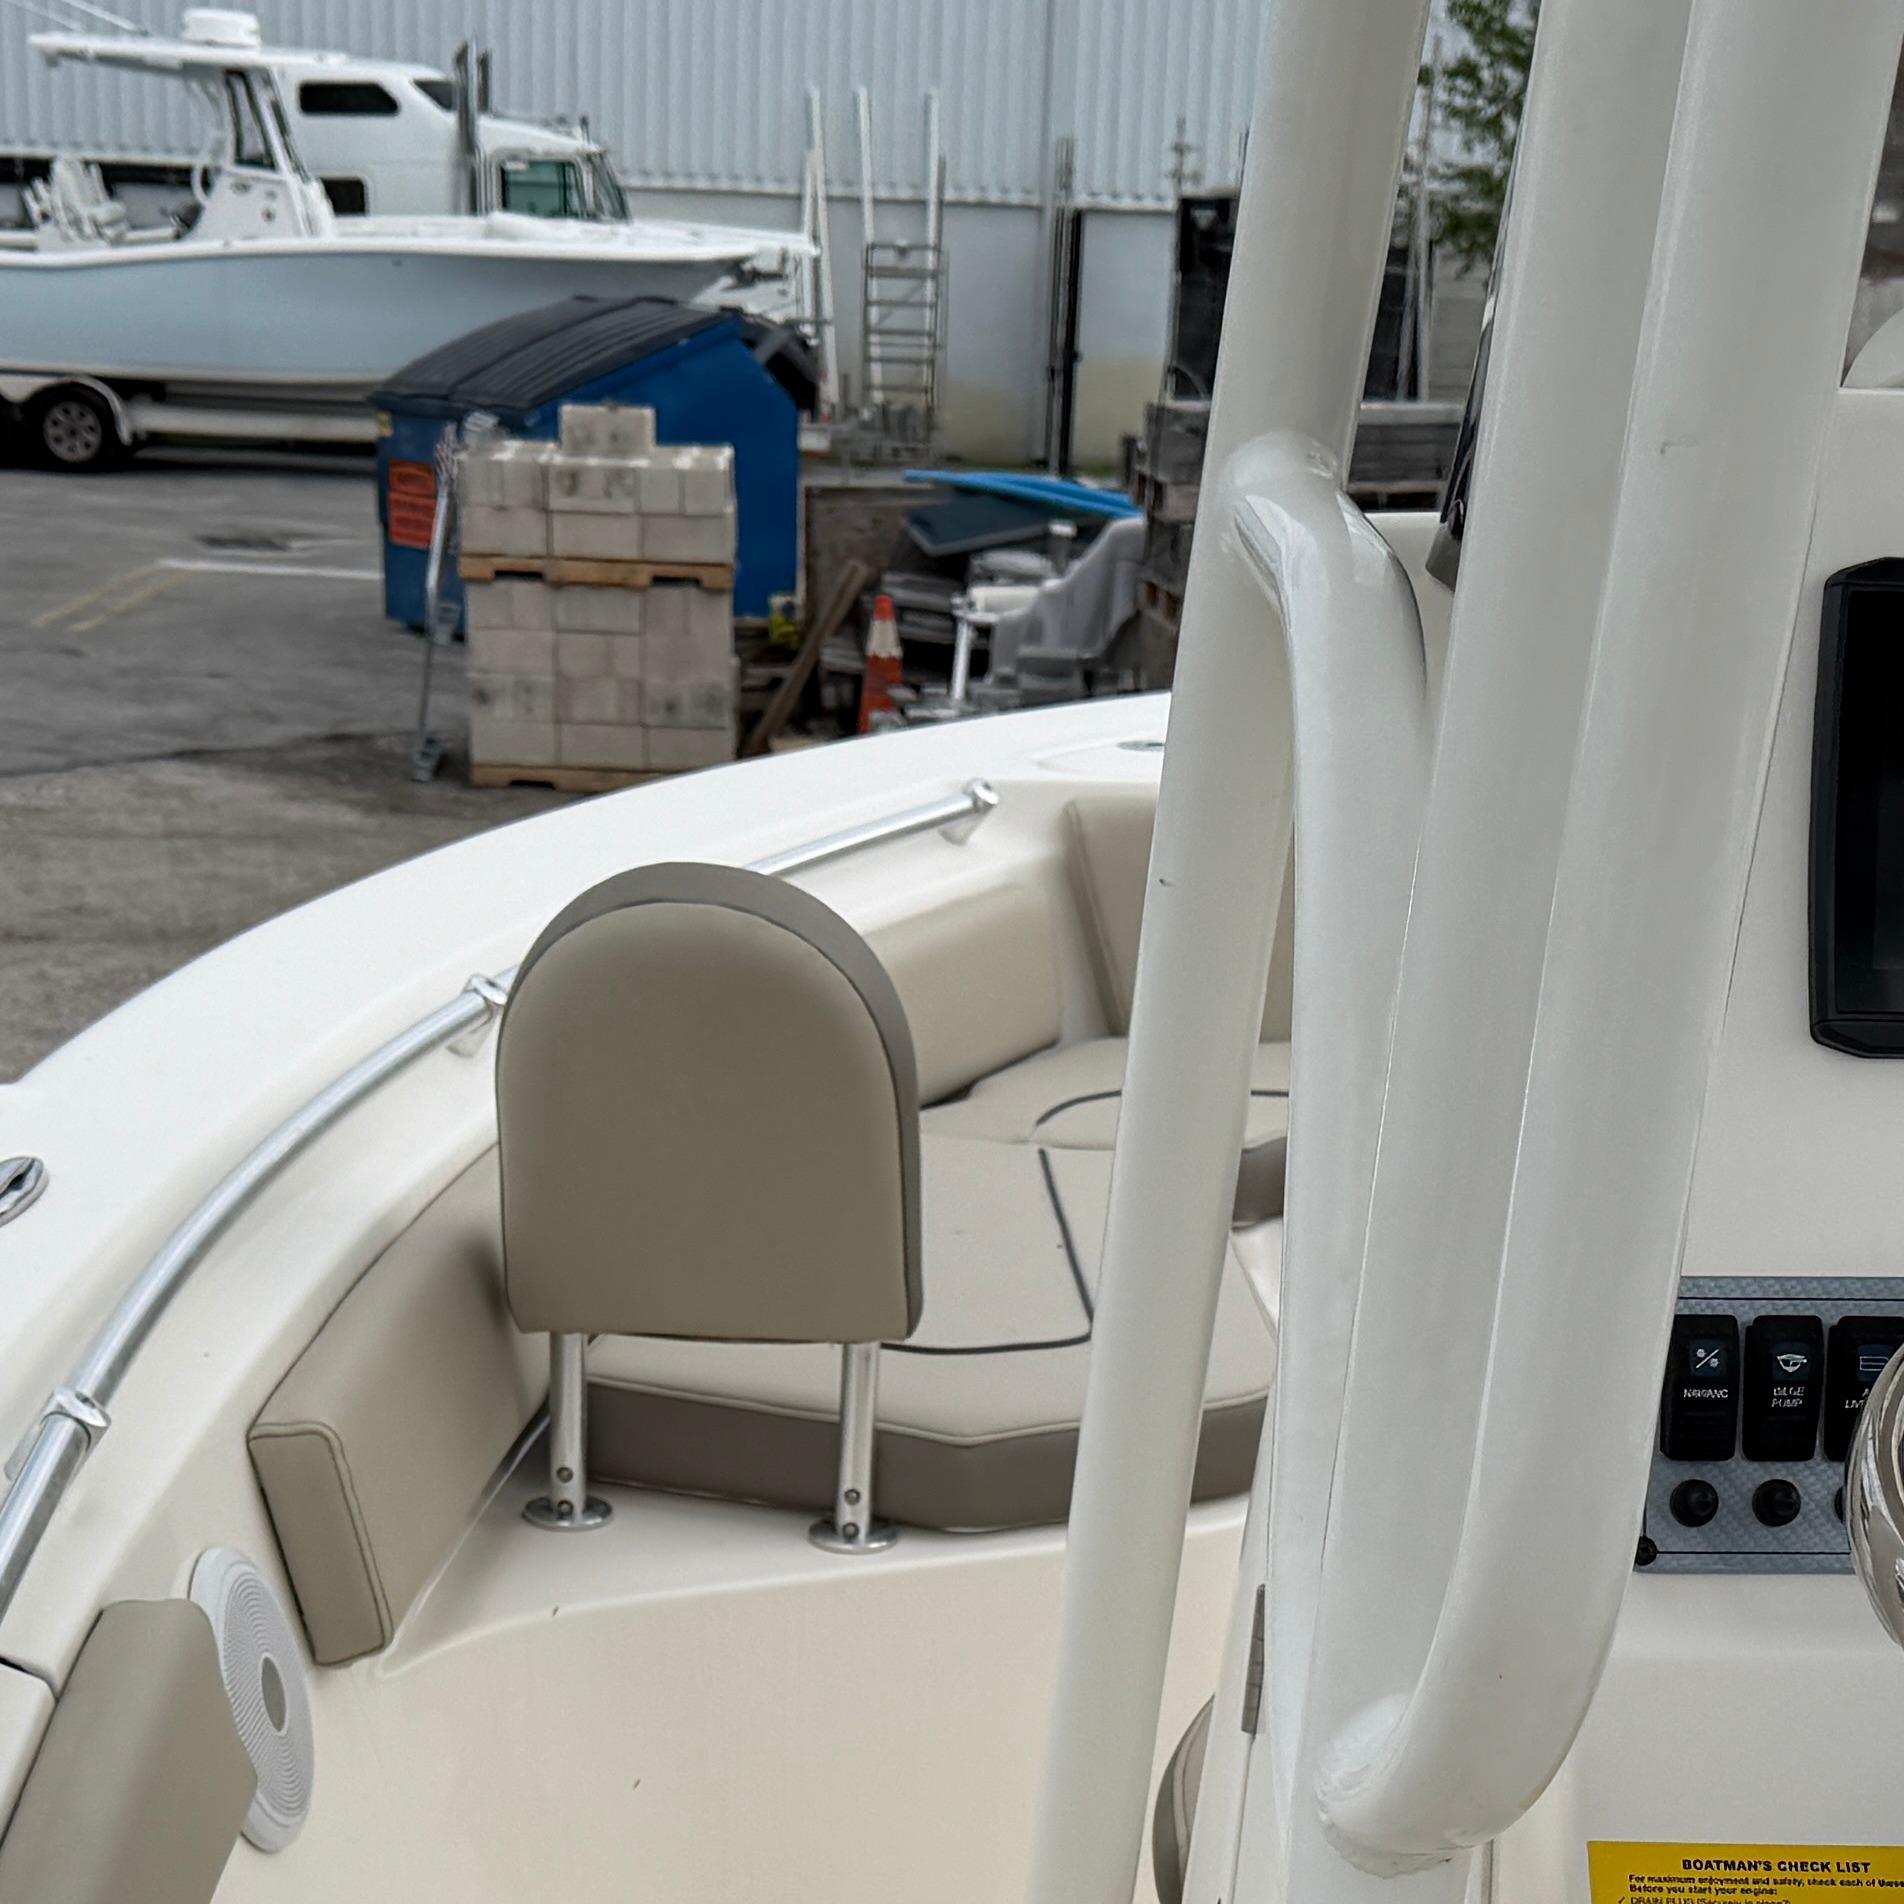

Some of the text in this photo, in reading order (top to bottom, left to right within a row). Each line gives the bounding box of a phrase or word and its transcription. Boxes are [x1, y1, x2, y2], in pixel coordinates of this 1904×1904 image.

[1682, 1859, 1870, 1873] BOATMAN'S CHECK LIST
[1628, 1875, 1645, 1883] For
[1807, 1879, 1837, 1887] check
[1839, 1879, 1863, 1887] each
[1630, 1885, 1663, 1893] Before
[1666, 1888, 1684, 1896] you
[1715, 1889, 1736, 1897] your
